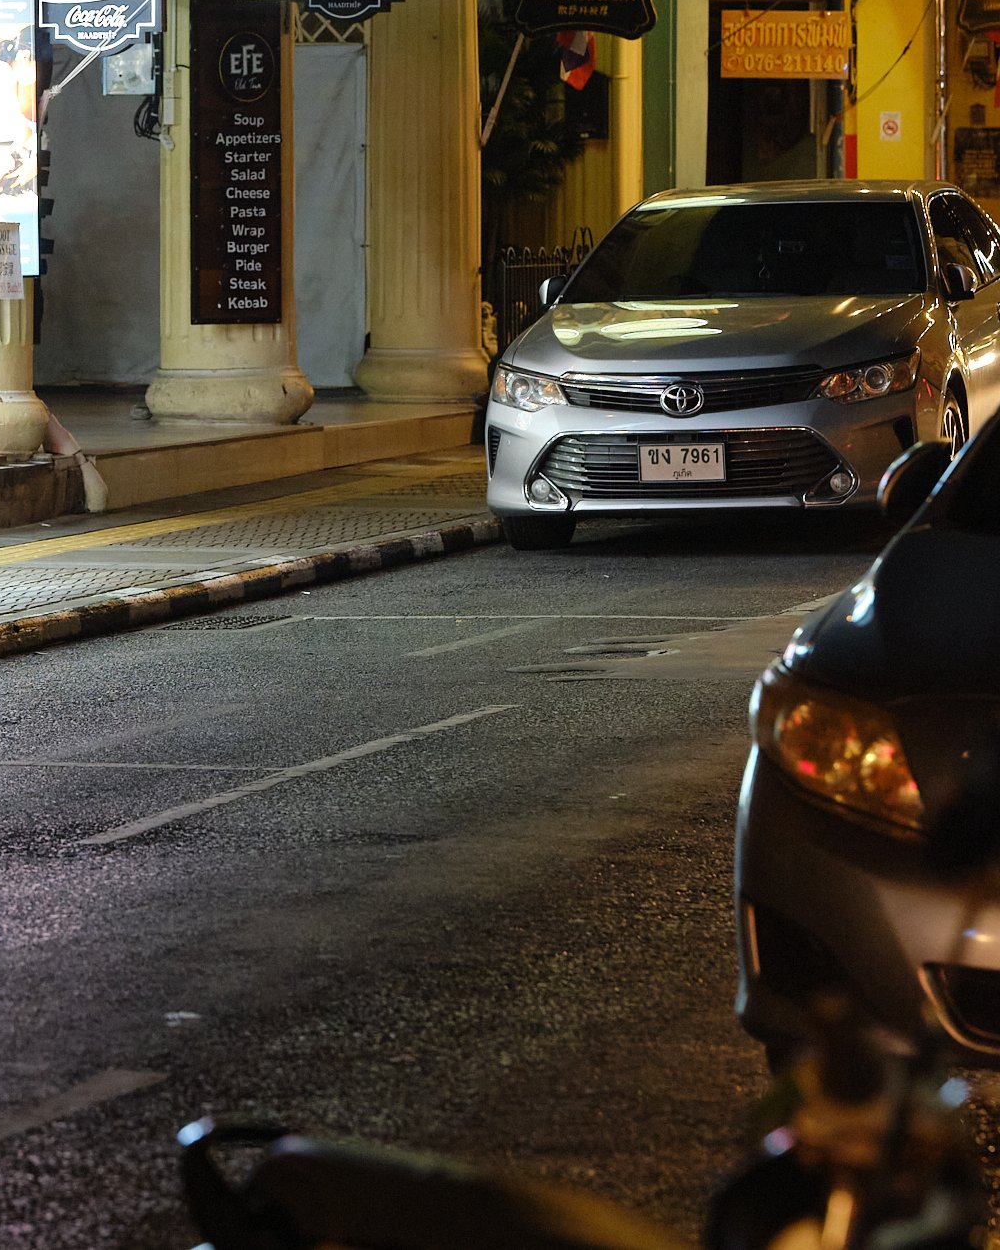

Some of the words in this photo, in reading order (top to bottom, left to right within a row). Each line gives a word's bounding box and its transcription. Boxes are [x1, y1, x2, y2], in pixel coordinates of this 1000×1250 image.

[64, 4, 130, 28] Coca-Cola
[230, 44, 265, 76] EFE
[744, 53, 845, 73] 076-211140
[234, 113, 265, 128] Soup
[216, 132, 281, 146] Appetizers
[224, 151, 272, 163] Starter
[230, 169, 265, 181] Salad
[226, 187, 270, 199] Cheese
[230, 206, 266, 218] Pasta
[232, 224, 265, 238] Wrap
[227, 241, 270, 255] Burger
[235, 259, 262, 271] Pide
[229, 277, 266, 290] Steak
[228, 297, 268, 309] Kebab
[680, 447, 720, 464] 7961
